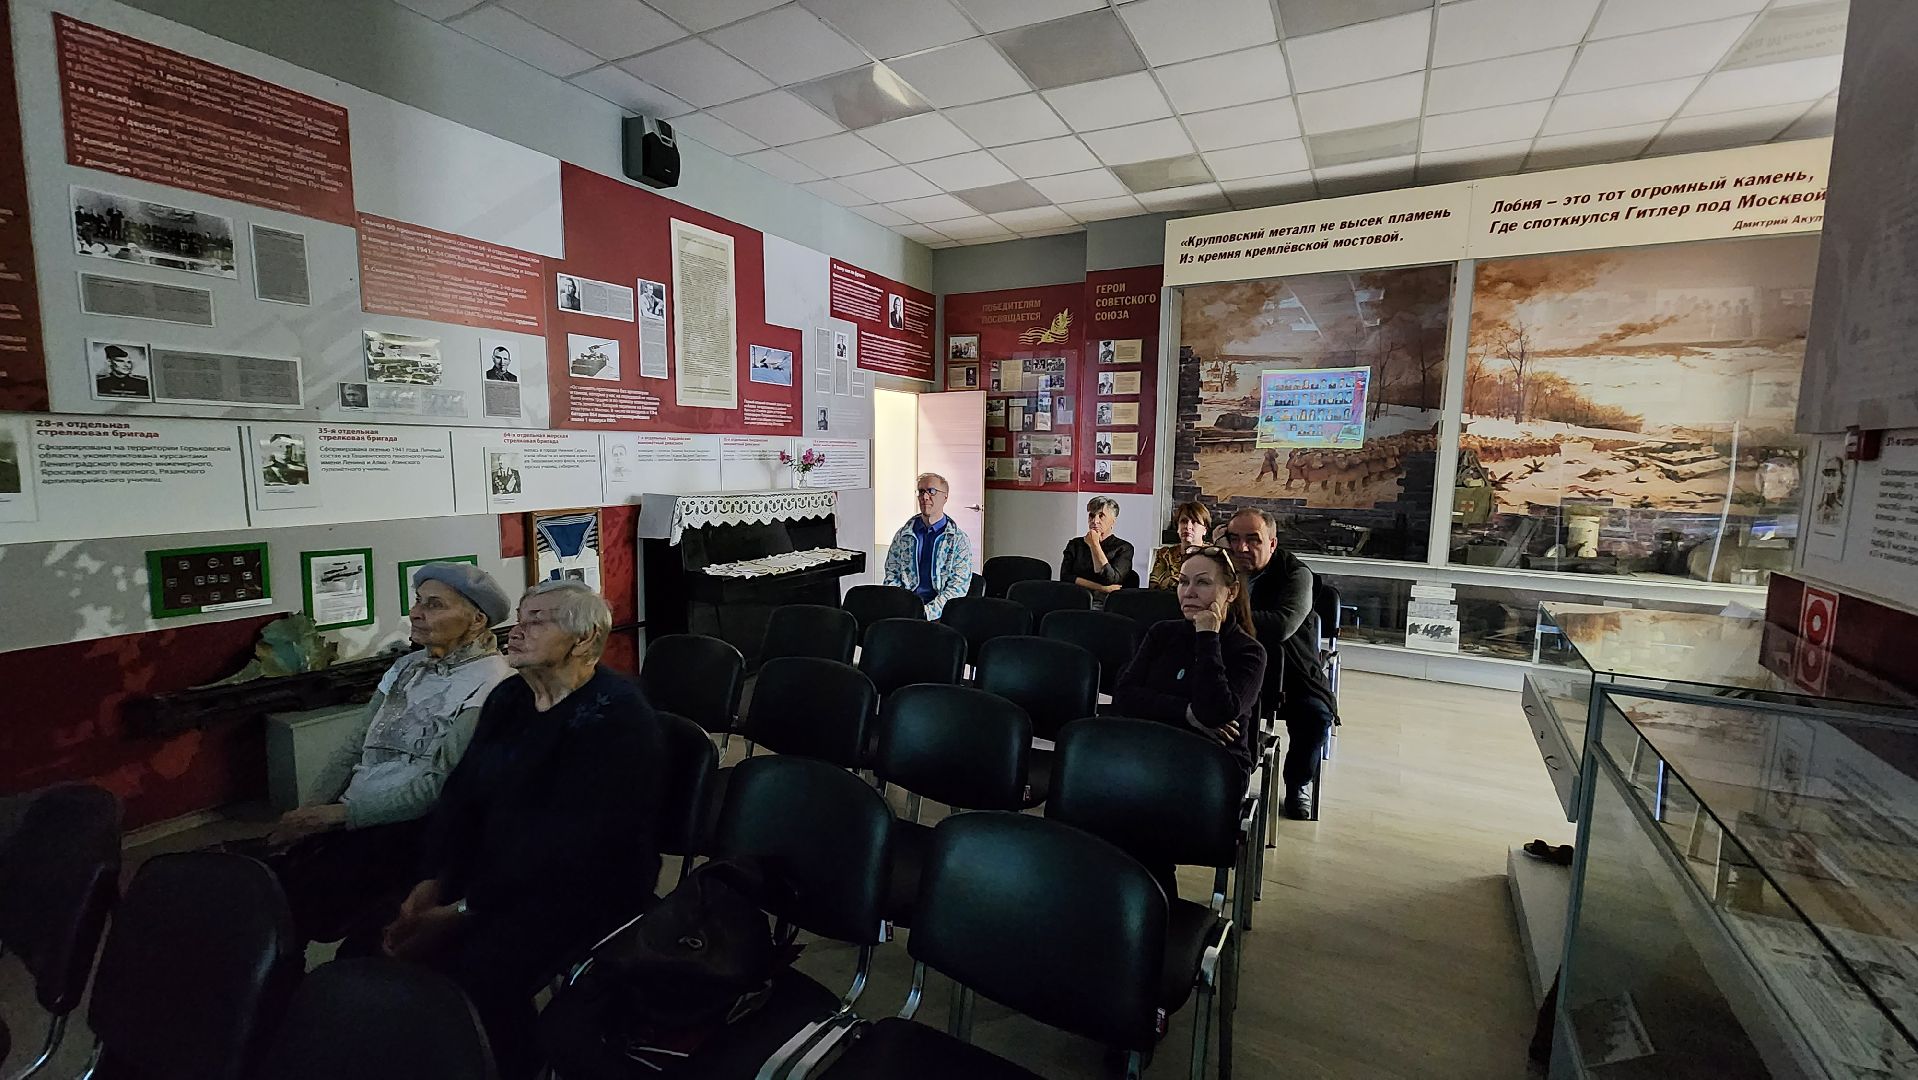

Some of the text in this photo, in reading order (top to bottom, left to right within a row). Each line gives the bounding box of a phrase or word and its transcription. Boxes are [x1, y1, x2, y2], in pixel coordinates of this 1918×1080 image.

[1491, 199, 1542, 213] Лобня
[1563, 194, 1590, 206] это
[1598, 190, 1626, 201] тот
[1631, 176, 1727, 199] огромный
[1733, 170, 1814, 188] камень,
[1489, 187, 1828, 234] Где споткнулся Гитлер под Москвой
[1181, 208, 1451, 247] «Крупповский металл не высек пламень
[1732, 217, 1788, 230] Дмитрий
[1179, 231, 1404, 264] Из кремня кремлёвской мостовой.
[1096, 283, 1125, 294] ГЕРОИ
[982, 300, 1041, 312] ПОБЕДИТЕЛЯМ
[1095, 293, 1156, 308] СОВЕТСКОГО
[982, 312, 1041, 324] ПОСВЯЩАЕТСЯ
[1095, 310, 1129, 321] СОЮЗА
[66, 421, 130, 429] отдельная
[37, 430, 159, 438] стрелковая бригада
